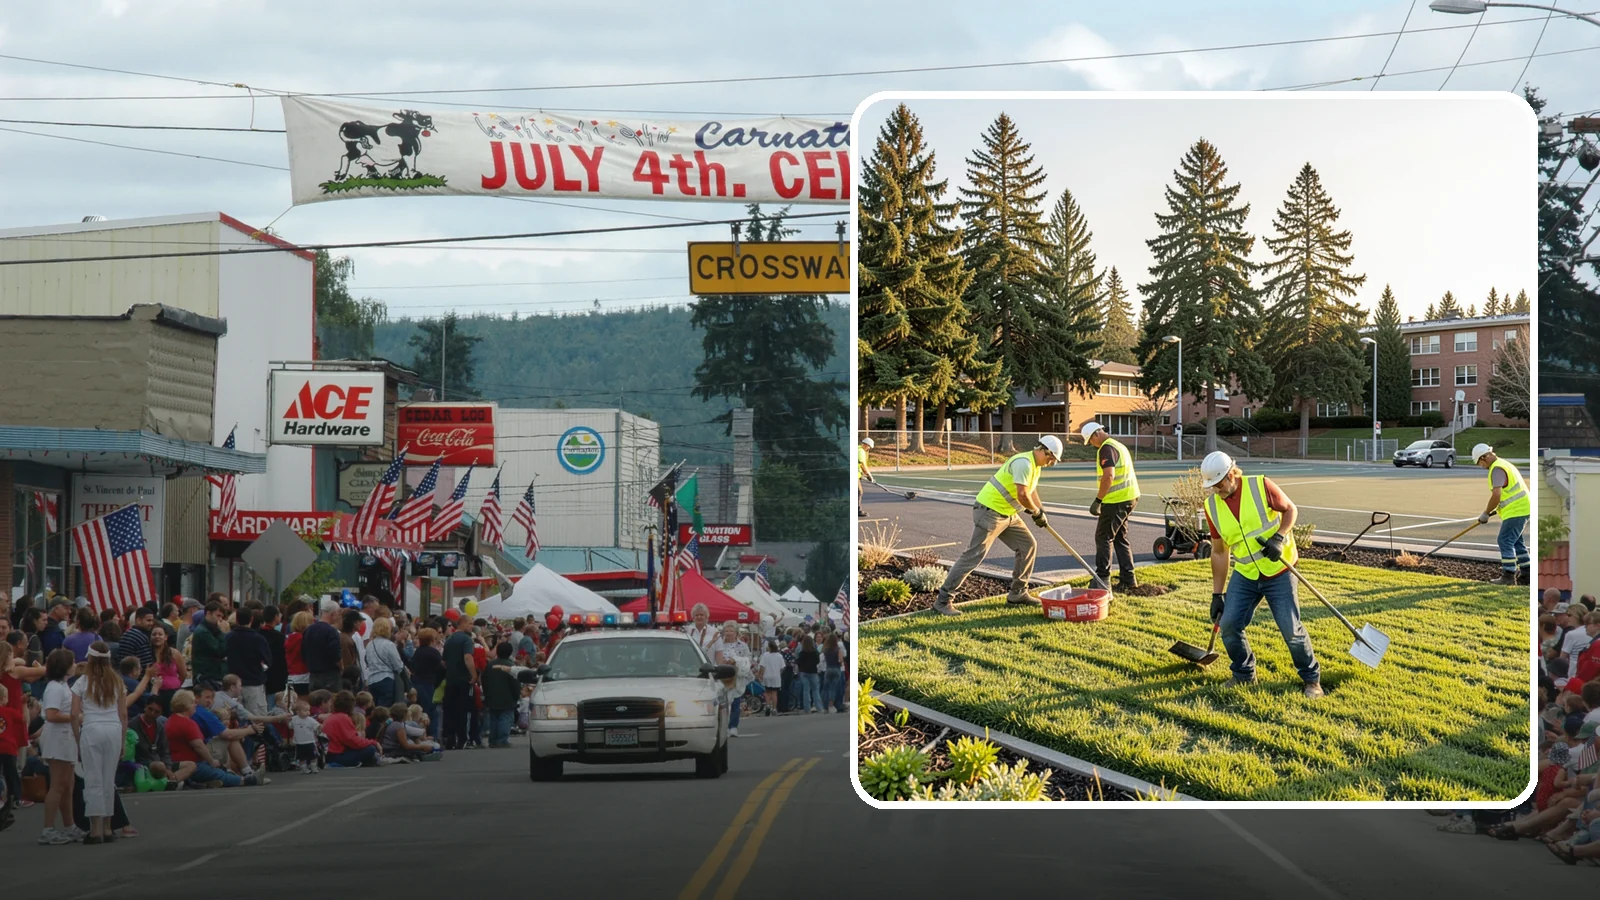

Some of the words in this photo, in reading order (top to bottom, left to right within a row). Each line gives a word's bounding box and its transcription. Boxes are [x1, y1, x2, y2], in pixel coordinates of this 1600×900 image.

[481, 141, 605, 193] JULY
[632, 150, 746, 198] 4th.
[697, 254, 850, 280] CROSSWA
[283, 380, 373, 420] ACE
[405, 409, 452, 422] CEDAR
[283, 421, 371, 436] Hardware
[416, 427, 477, 447] Coca-Cola
[353, 466, 385, 480] Simpl
[83, 484, 94, 495] St.
[96, 485, 124, 495] Vincent
[126, 486, 136, 495] de
[138, 485, 155, 495] Paul
[213, 516, 331, 535] HARDARE
[688, 526, 741, 535] CRNATION
[699, 535, 730, 543] GLASS
